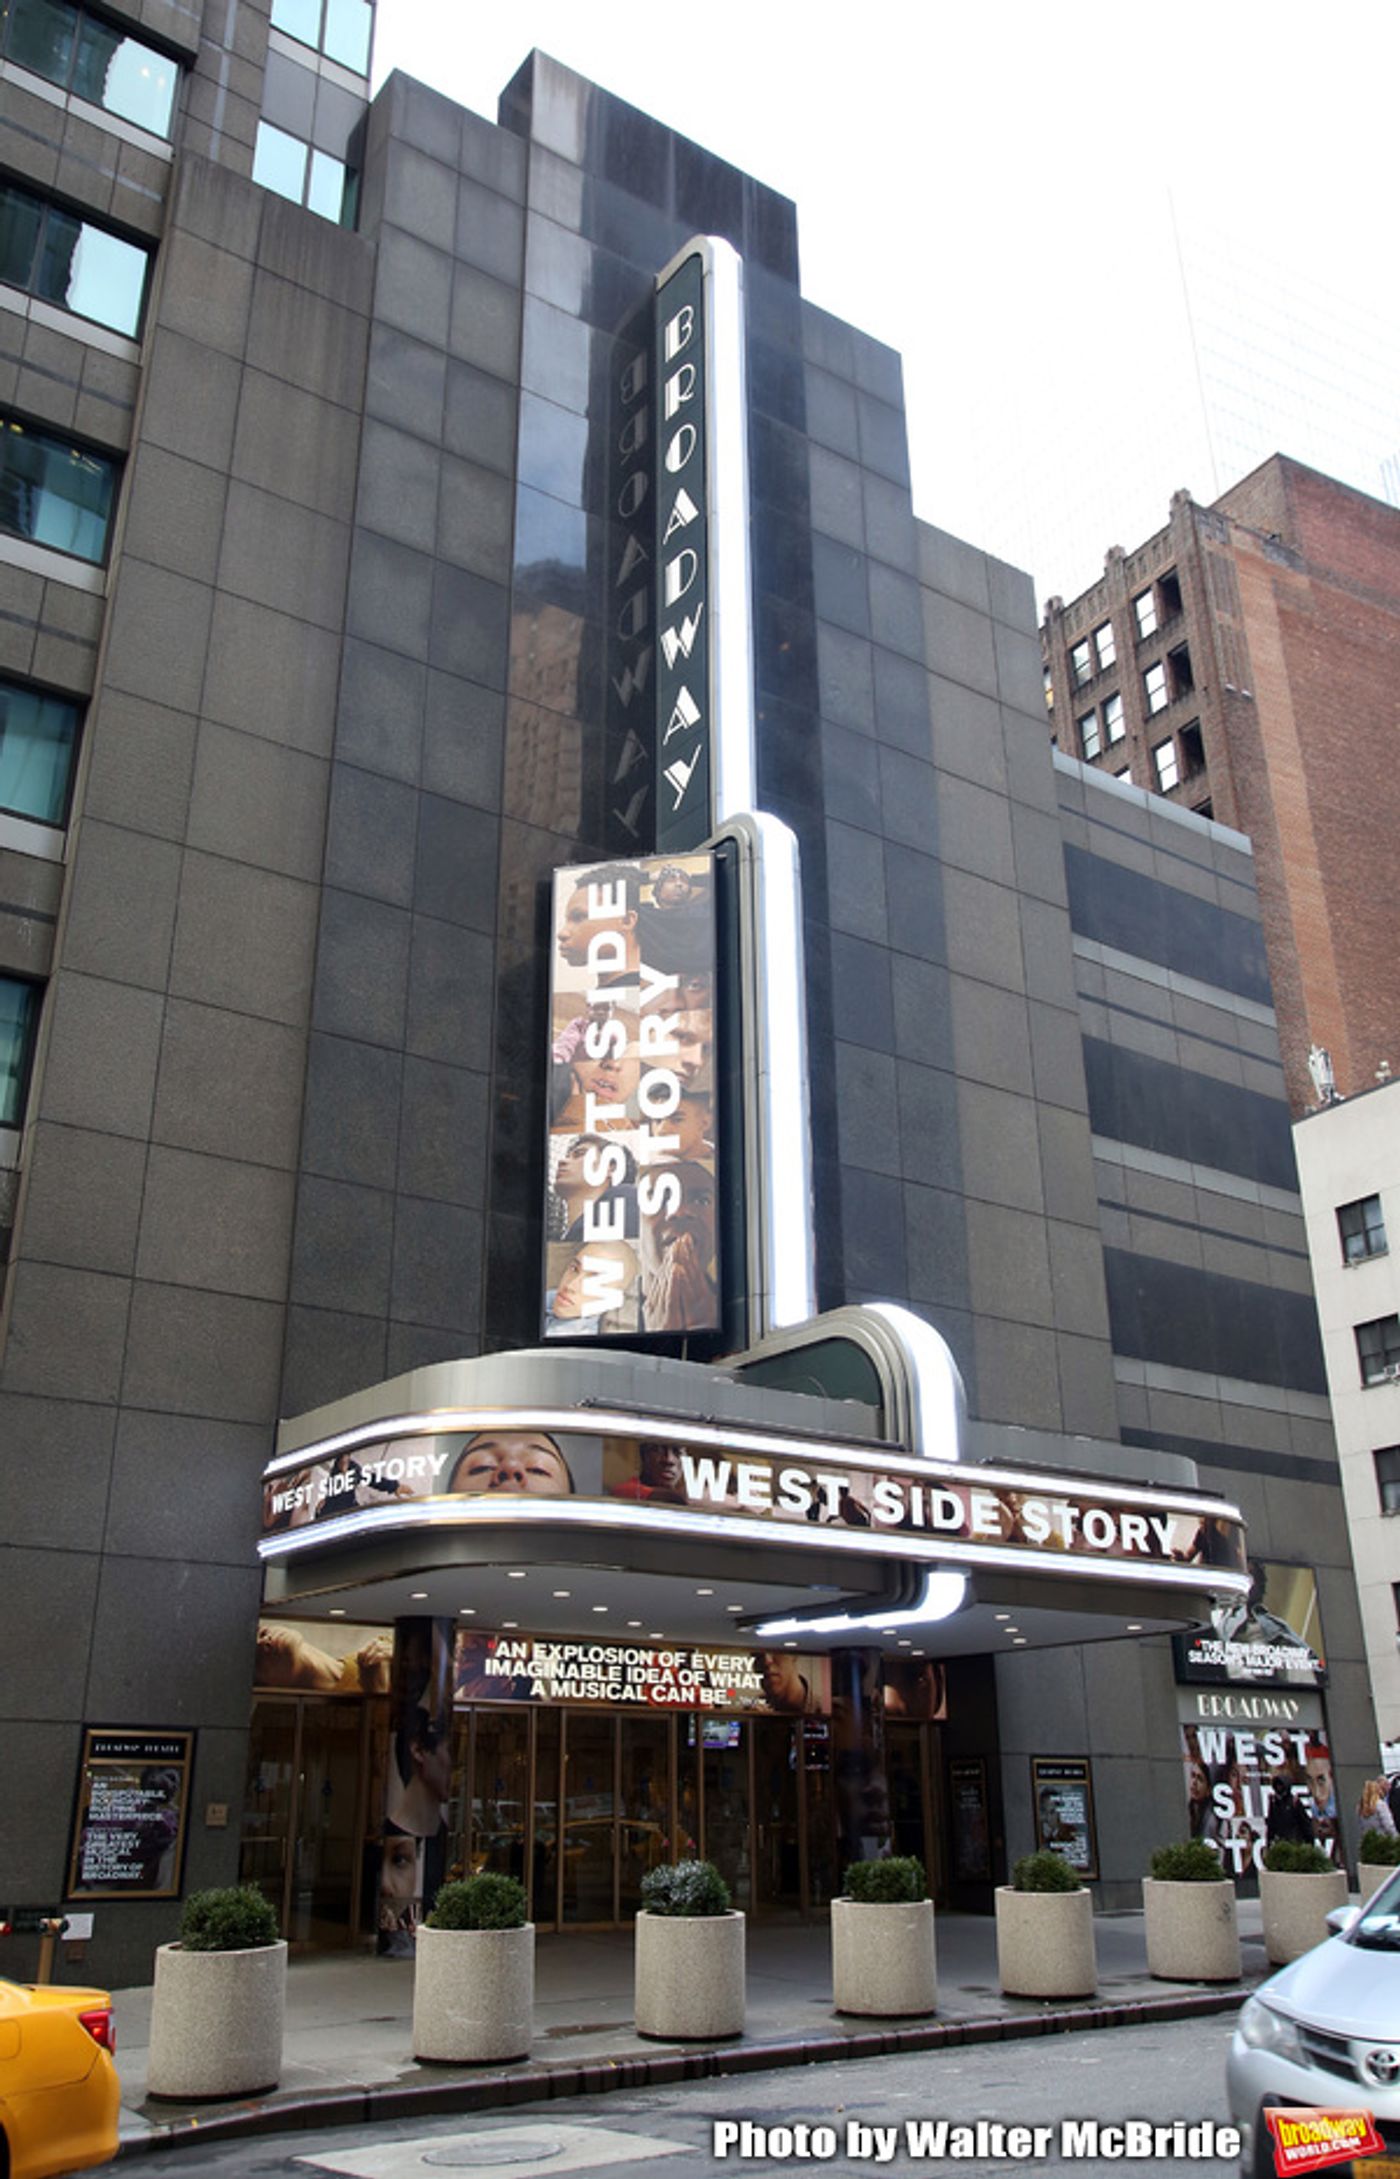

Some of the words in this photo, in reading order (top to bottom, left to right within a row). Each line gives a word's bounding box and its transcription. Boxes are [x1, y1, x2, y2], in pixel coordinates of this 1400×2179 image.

[660, 305, 703, 811] BROADWAY
[586, 879, 626, 1062] SIDE
[636, 961, 681, 1219] STORY
[581, 1092, 625, 1319] WEST
[272, 1483, 314, 1515] WEST
[318, 1471, 355, 1500] SIDE
[360, 1453, 448, 1487] STORY
[681, 1455, 851, 1517] WEST
[872, 1480, 1002, 1537] SIDE
[1023, 1499, 1178, 1556] STORY
[485, 1659, 622, 1682] IMAGINABLE
[627, 1666, 674, 1685] IDEA
[679, 1669, 706, 1686] OF
[709, 1671, 764, 1689] WHAT
[532, 1643, 652, 1666] EXPLOSION
[660, 1651, 687, 1668] OF
[691, 1653, 756, 1672] EVERY
[530, 1680, 545, 1696] A
[551, 1681, 648, 1701] MUSICAL
[651, 1685, 696, 1703] CAN
[1197, 1694, 1299, 1721] BROADWAY
[1196, 1728, 1310, 1766] WEST
